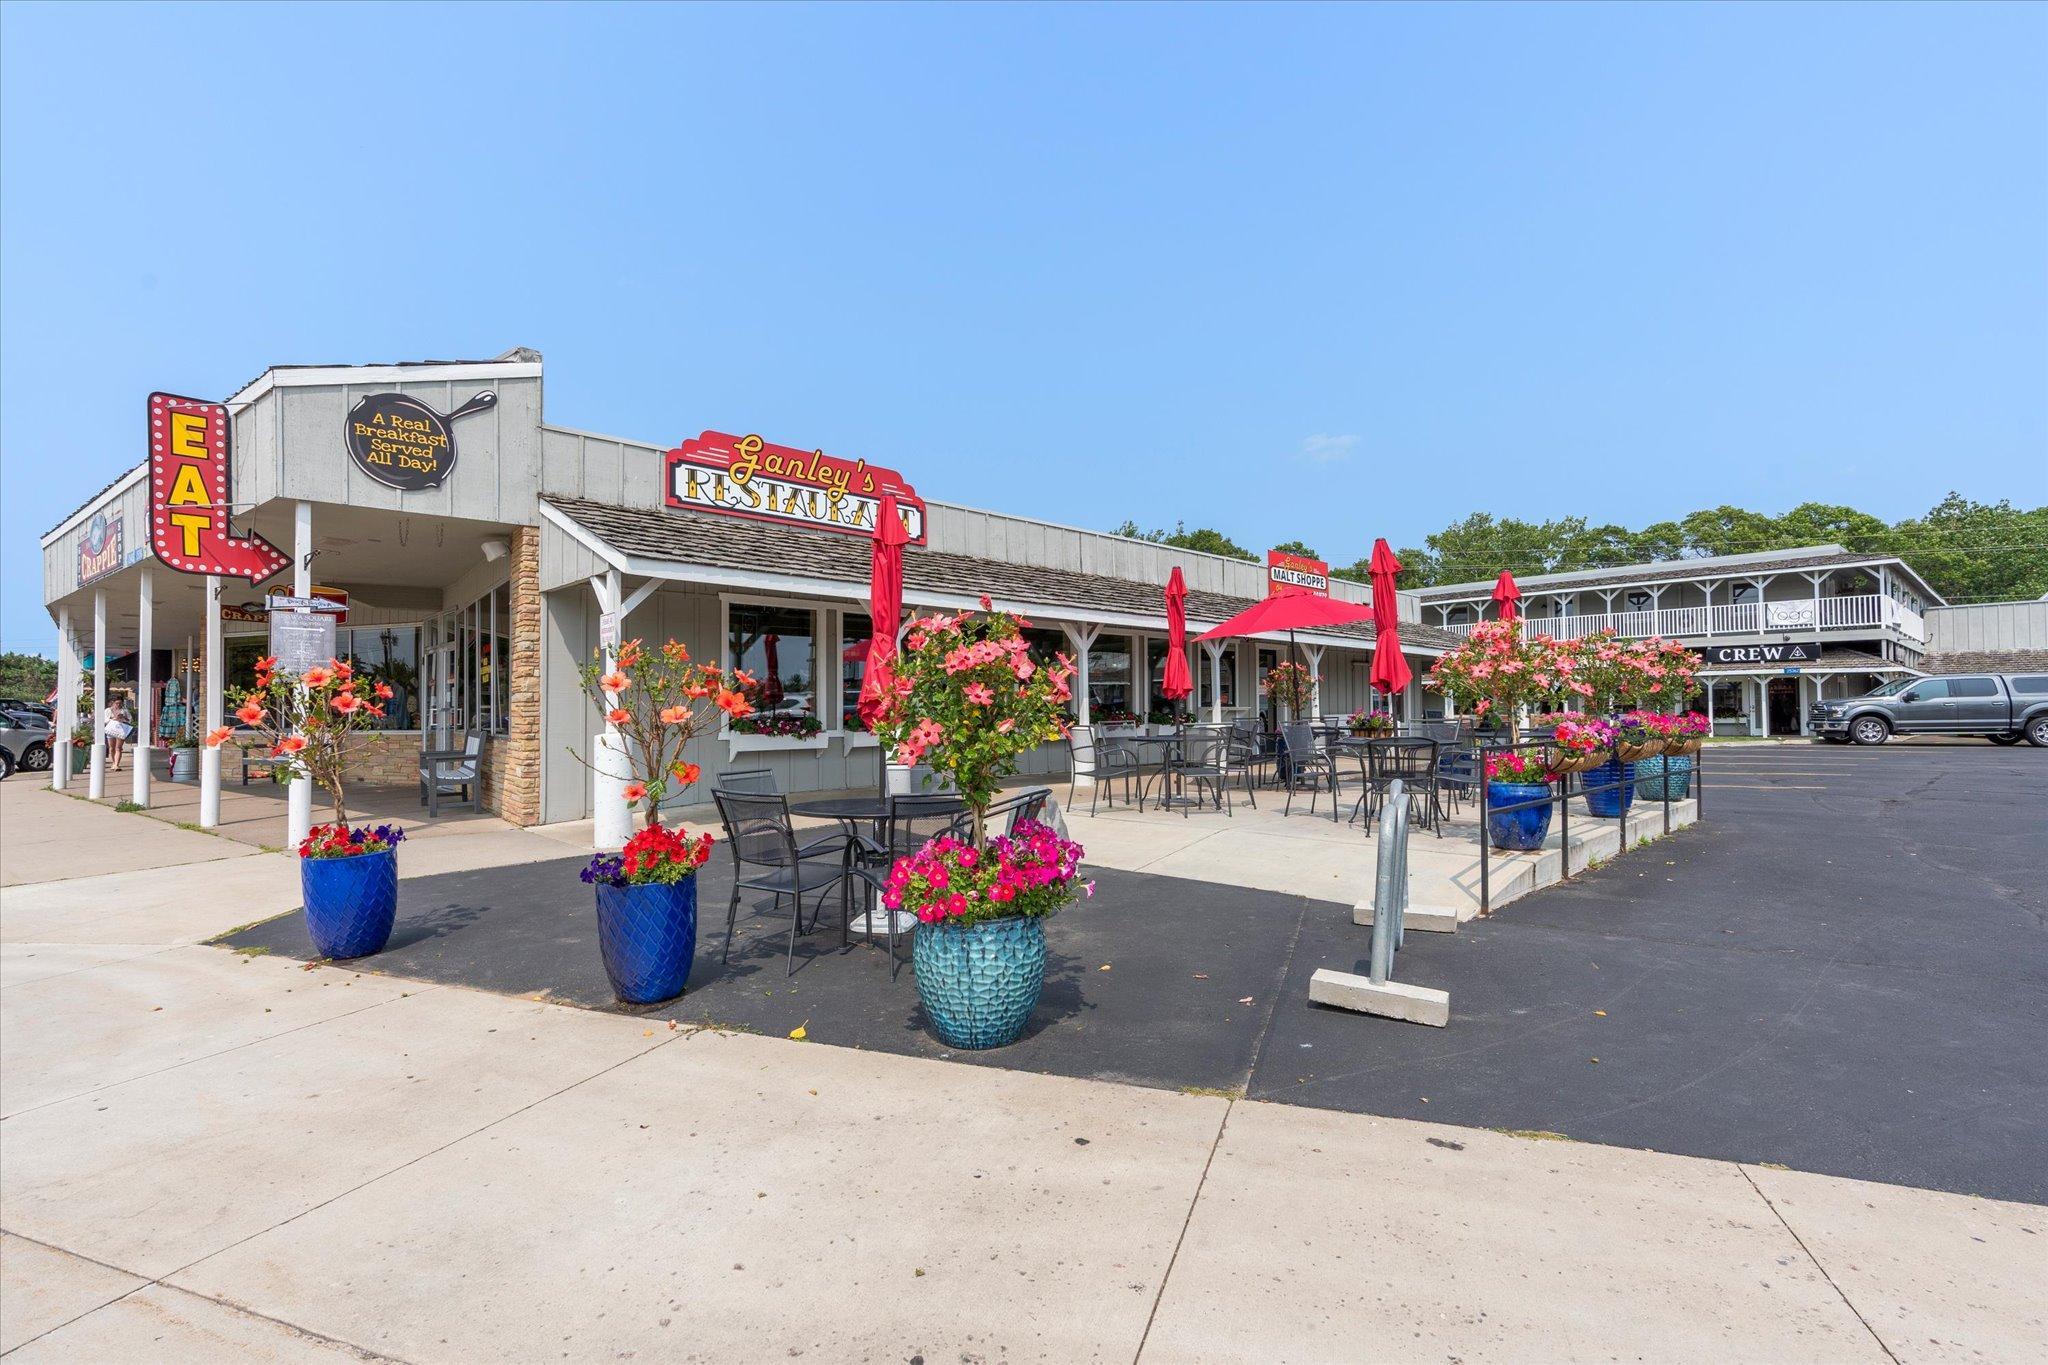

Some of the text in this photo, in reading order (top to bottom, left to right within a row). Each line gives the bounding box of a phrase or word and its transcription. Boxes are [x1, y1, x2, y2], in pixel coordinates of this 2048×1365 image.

[372, 413, 431, 432] A Real
[354, 423, 448, 447] Breakfast
[371, 438, 433, 458] Served
[366, 452, 437, 472] All Day!
[728, 434, 876, 502] Ganley's
[166, 411, 214, 558] EAT
[684, 467, 916, 535] RESTAURAT
[81, 533, 118, 580] CRAPPIE
[1273, 569, 1295, 582] MALT
[1296, 573, 1325, 588] SHOPPE
[1767, 606, 1813, 623] Yoga
[1719, 646, 1784, 661] CREW
